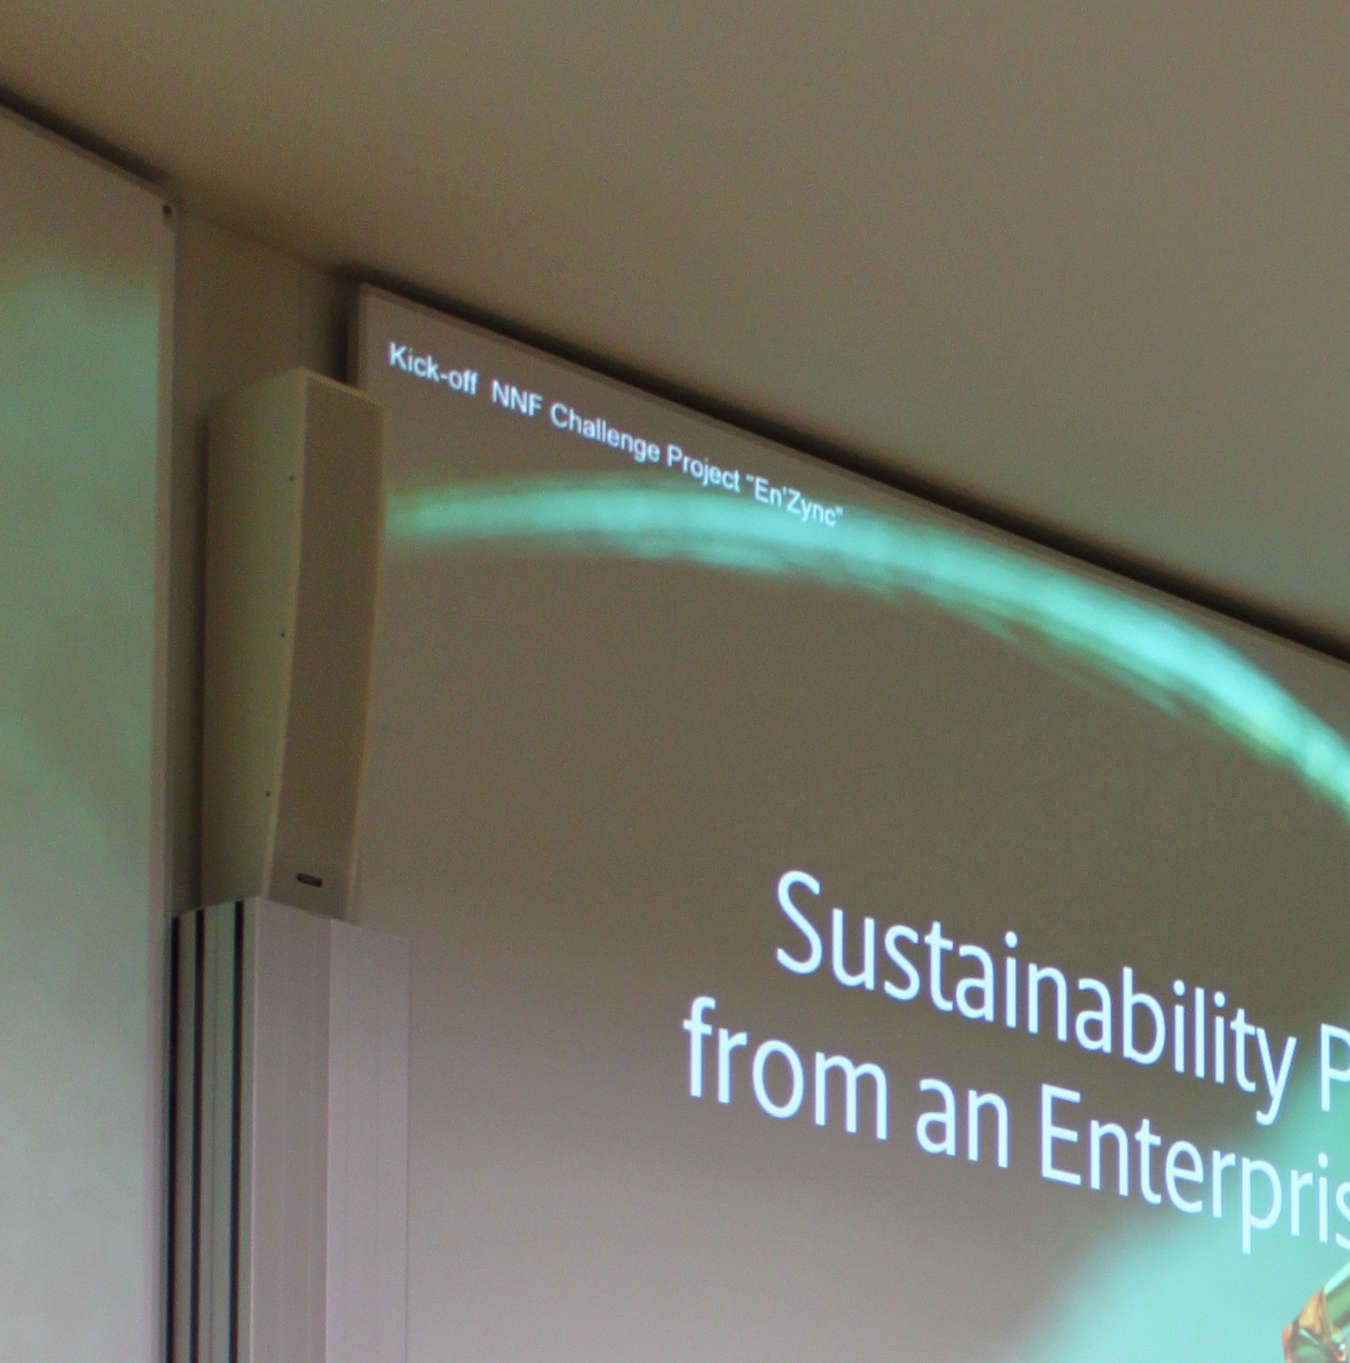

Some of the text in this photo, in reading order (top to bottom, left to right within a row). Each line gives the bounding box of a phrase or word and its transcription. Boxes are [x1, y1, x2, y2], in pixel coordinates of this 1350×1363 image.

[388, 342, 479, 396] Kick-off
[491, 380, 544, 417] NNF
[549, 402, 661, 464] Challenge
[666, 444, 741, 494] Project
[681, 995, 889, 1141] from
[916, 1074, 1009, 1169] an
[775, 869, 1297, 1126] Sustainability
